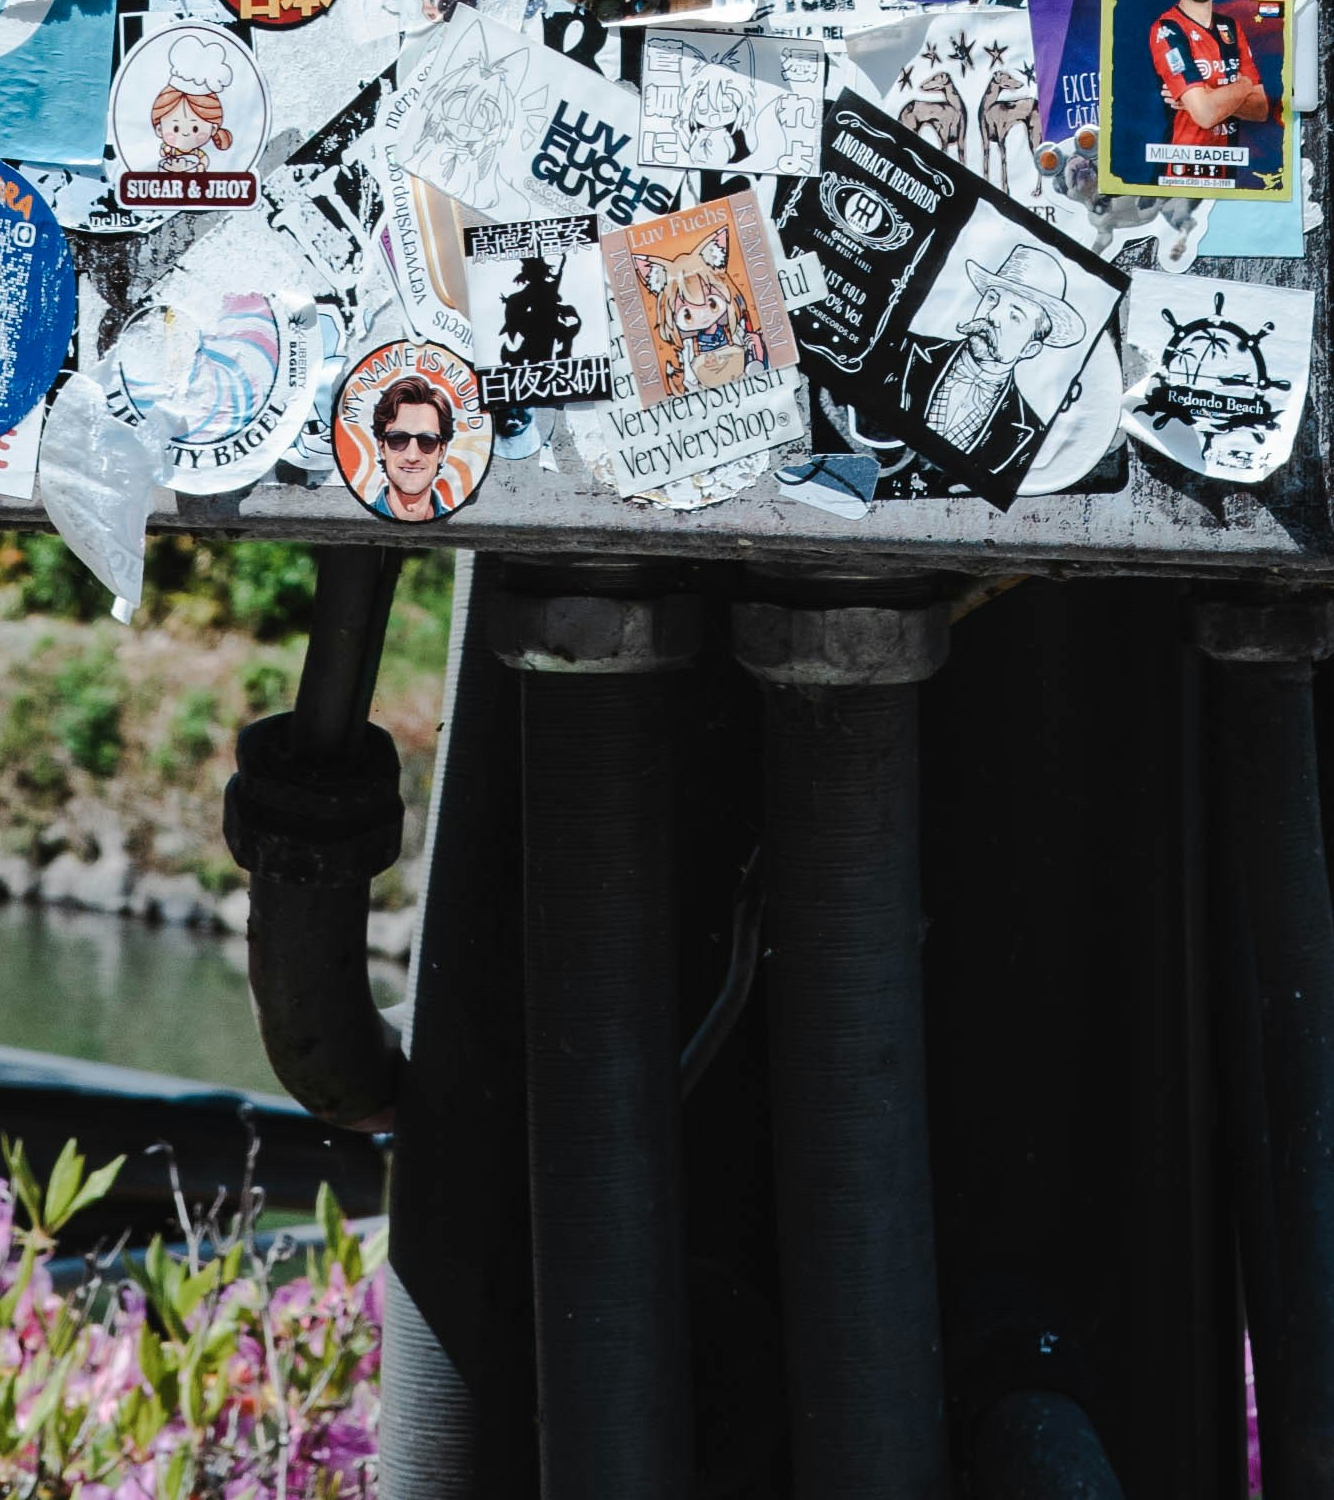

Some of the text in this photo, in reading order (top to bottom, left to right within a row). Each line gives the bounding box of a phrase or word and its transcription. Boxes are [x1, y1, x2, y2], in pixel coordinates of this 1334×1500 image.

[551, 100, 632, 154] LUV
[539, 124, 673, 212] FUCHS
[832, 130, 942, 215] ANORRACK RECORDS
[1150, 147, 1245, 163] MILAN BADELJ
[126, 179, 252, 200] SUGAR & JHOY
[531, 154, 636, 225] GUYS
[629, 206, 728, 249] Luv Fuchs
[831, 228, 864, 255] QUALITY
[342, 345, 486, 433] MY NAME IS MUDD
[1168, 388, 1264, 416] Redondo Beach
